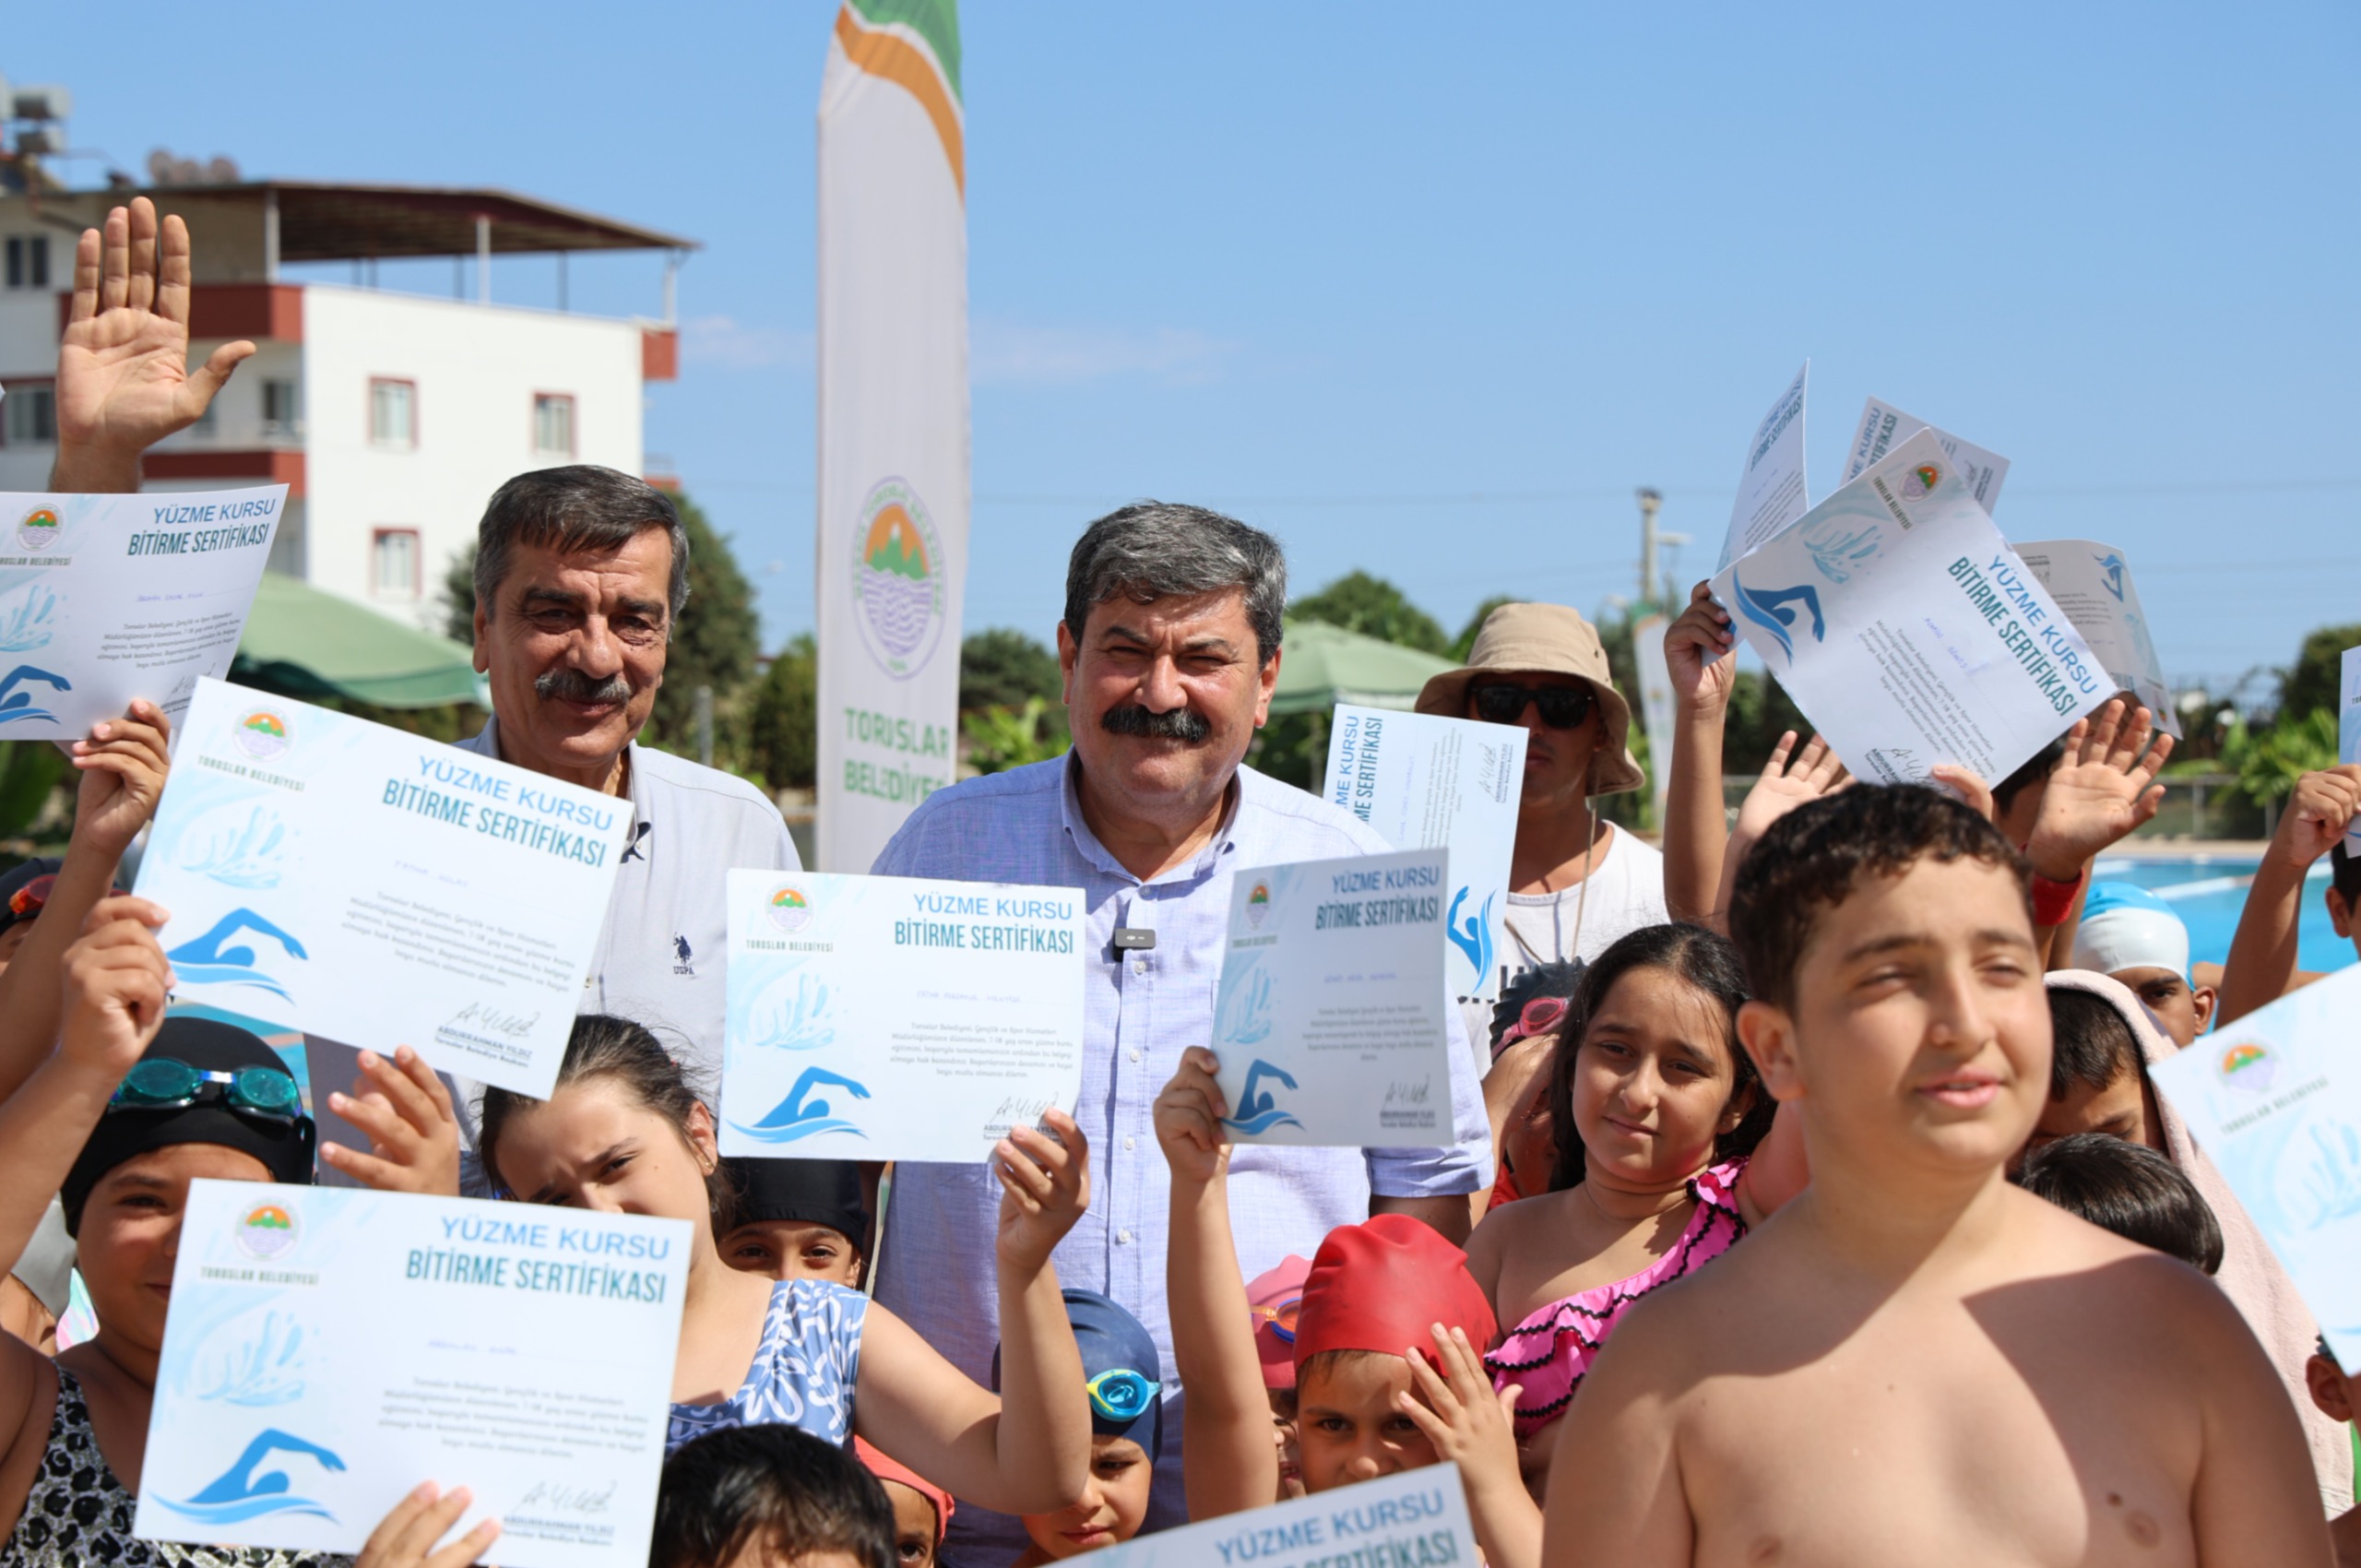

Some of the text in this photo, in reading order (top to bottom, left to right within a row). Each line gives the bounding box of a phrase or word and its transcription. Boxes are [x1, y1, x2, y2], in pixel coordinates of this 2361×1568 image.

[1857, 407, 1881, 458] KURSU
[154, 499, 276, 524] YÜZME KURSU
[127, 523, 269, 556] BİTİRME SERTİFİKASI
[1947, 556, 2078, 717] BİTİRME SERTİFİKASI
[1987, 555, 2047, 627] YÜZME
[2039, 624, 2098, 695] KURSU
[1339, 716, 1359, 775] KURSU
[1356, 717, 1382, 798] SERTİFİKASI
[420, 755, 613, 831] YÜZME KURSU
[382, 778, 607, 868] BİTİRME SERTİFİKASI
[1333, 866, 1440, 894] YÜZME KURSU
[914, 894, 1072, 921] YÜZME KURSU
[1315, 896, 1439, 931] BİTİRME SERTİFİKASI
[895, 918, 1074, 954] BİTİRME SERTİFİKASI
[673, 966, 694, 975] USPA
[442, 1217, 670, 1261] YÜZME KURSU
[406, 1250, 666, 1303] BİTİRME SERTİFİKASI
[1216, 1490, 1444, 1565] YÜZME KURSU
